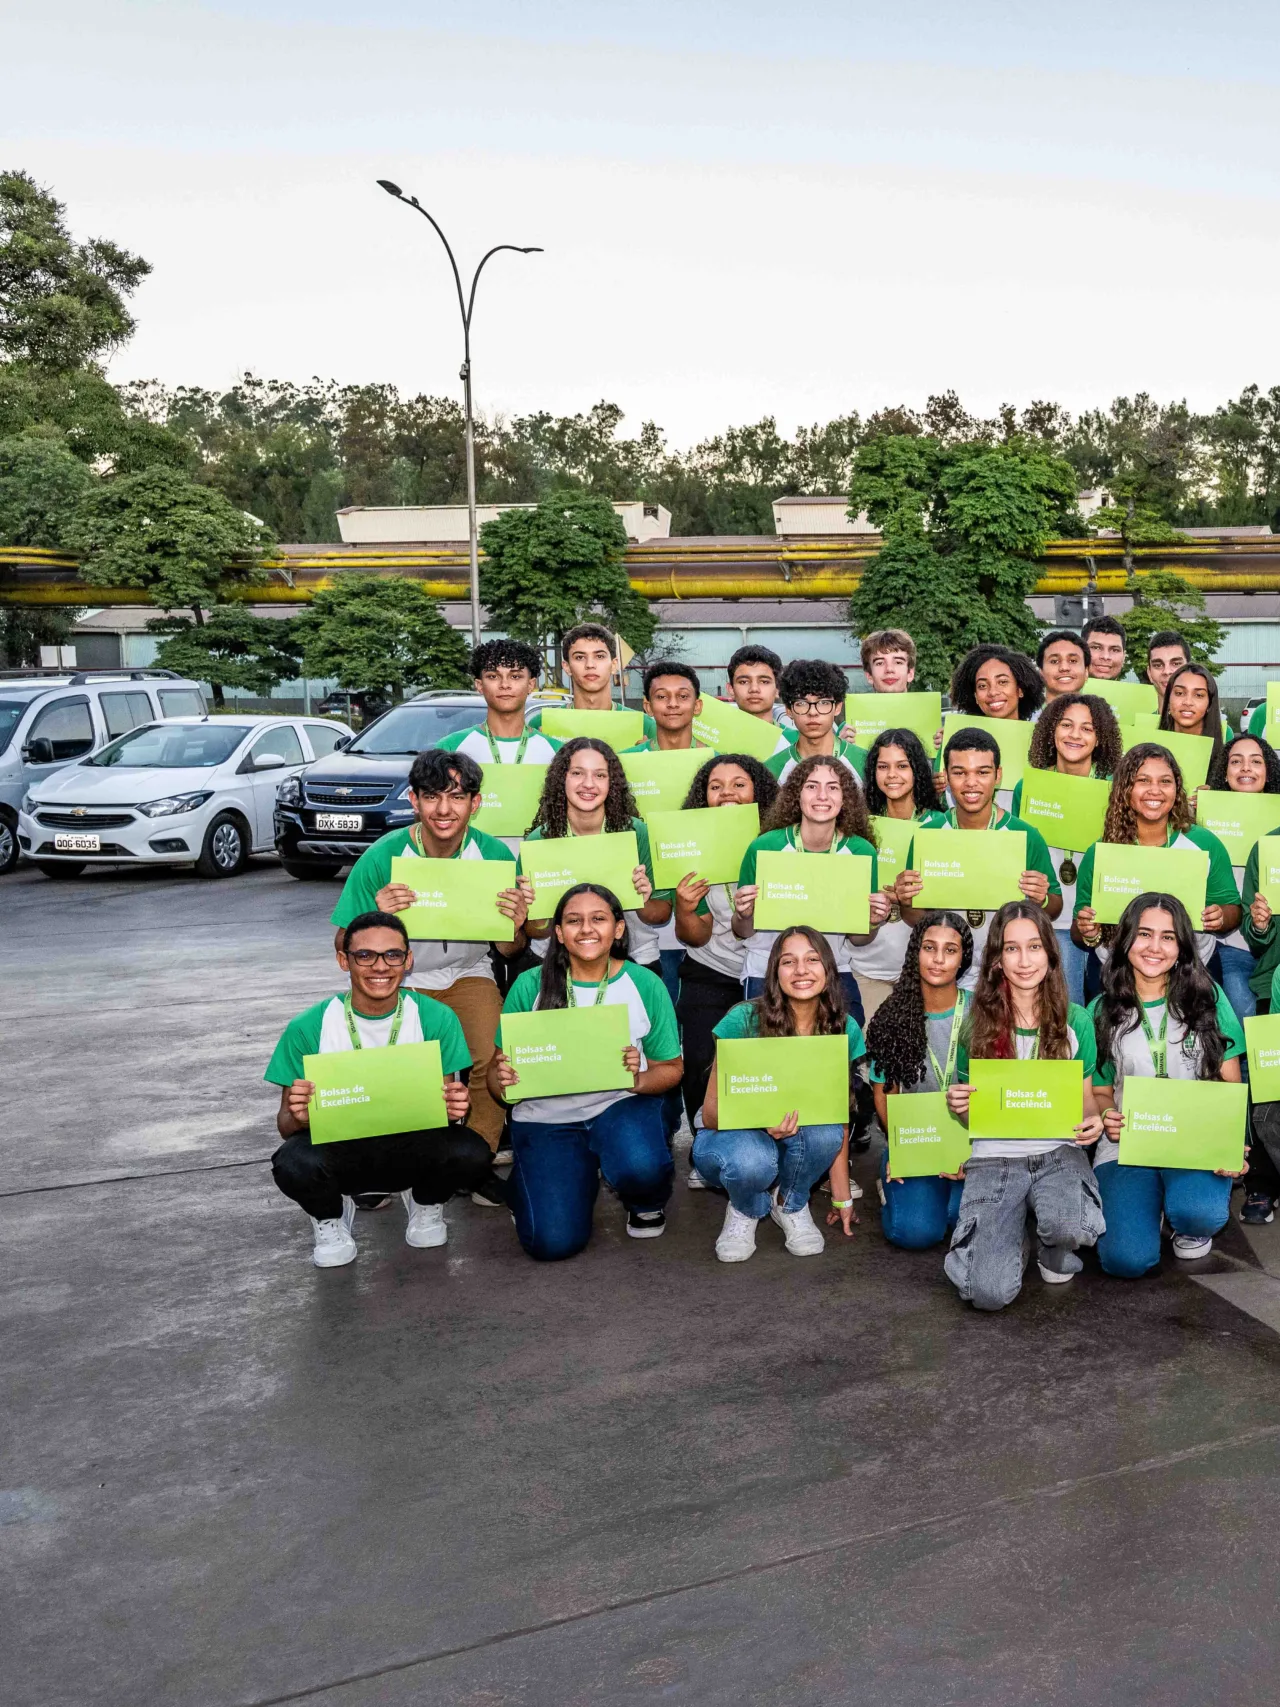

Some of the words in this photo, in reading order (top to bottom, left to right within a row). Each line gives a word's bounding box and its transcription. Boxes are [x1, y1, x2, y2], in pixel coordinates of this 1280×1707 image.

[855, 720, 874, 728] Bolsas
[646, 780, 656, 788] de
[634, 787, 660, 796] celência
[1030, 798, 1049, 808] Bolsas
[1051, 802, 1062, 810] de
[1028, 806, 1064, 819] Excelência
[1206, 819, 1227, 828] Bolsas
[1209, 827, 1244, 837] xcelência
[687, 840, 696, 848] de
[660, 849, 702, 859] Excelência
[924, 860, 948, 869] Bolsas
[950, 860, 961, 868] de
[534, 871, 560, 879] Bolsas
[924, 868, 964, 878] Excelência
[535, 878, 577, 888] Excelência
[1104, 876, 1129, 884] Bolsas
[1130, 877, 1140, 885] de
[768, 882, 793, 890] Bolsas
[1103, 884, 1145, 894] Excelência
[432, 890, 444, 898] de
[766, 891, 808, 900] Excelência
[348, 1012, 356, 1034] USIMINAS
[515, 1045, 544, 1054] Bolsas
[546, 1044, 557, 1052] de
[515, 1053, 562, 1064] Excelência
[730, 1074, 760, 1084] Bolsas
[762, 1074, 774, 1082] de
[320, 1086, 350, 1098] Bolsas
[352, 1085, 364, 1093] de
[730, 1084, 778, 1094] Excelência
[1005, 1089, 1034, 1098] Bolsas
[1036, 1090, 1048, 1098] de
[321, 1094, 370, 1108] Excelência
[1006, 1099, 1052, 1108] Excelência
[1134, 1112, 1160, 1121] Bolsas
[1162, 1114, 1173, 1122] de
[899, 1126, 924, 1134] Bolsas
[926, 1126, 937, 1134] de
[1132, 1122, 1177, 1133] Excelência
[900, 1134, 942, 1144] Excelência
